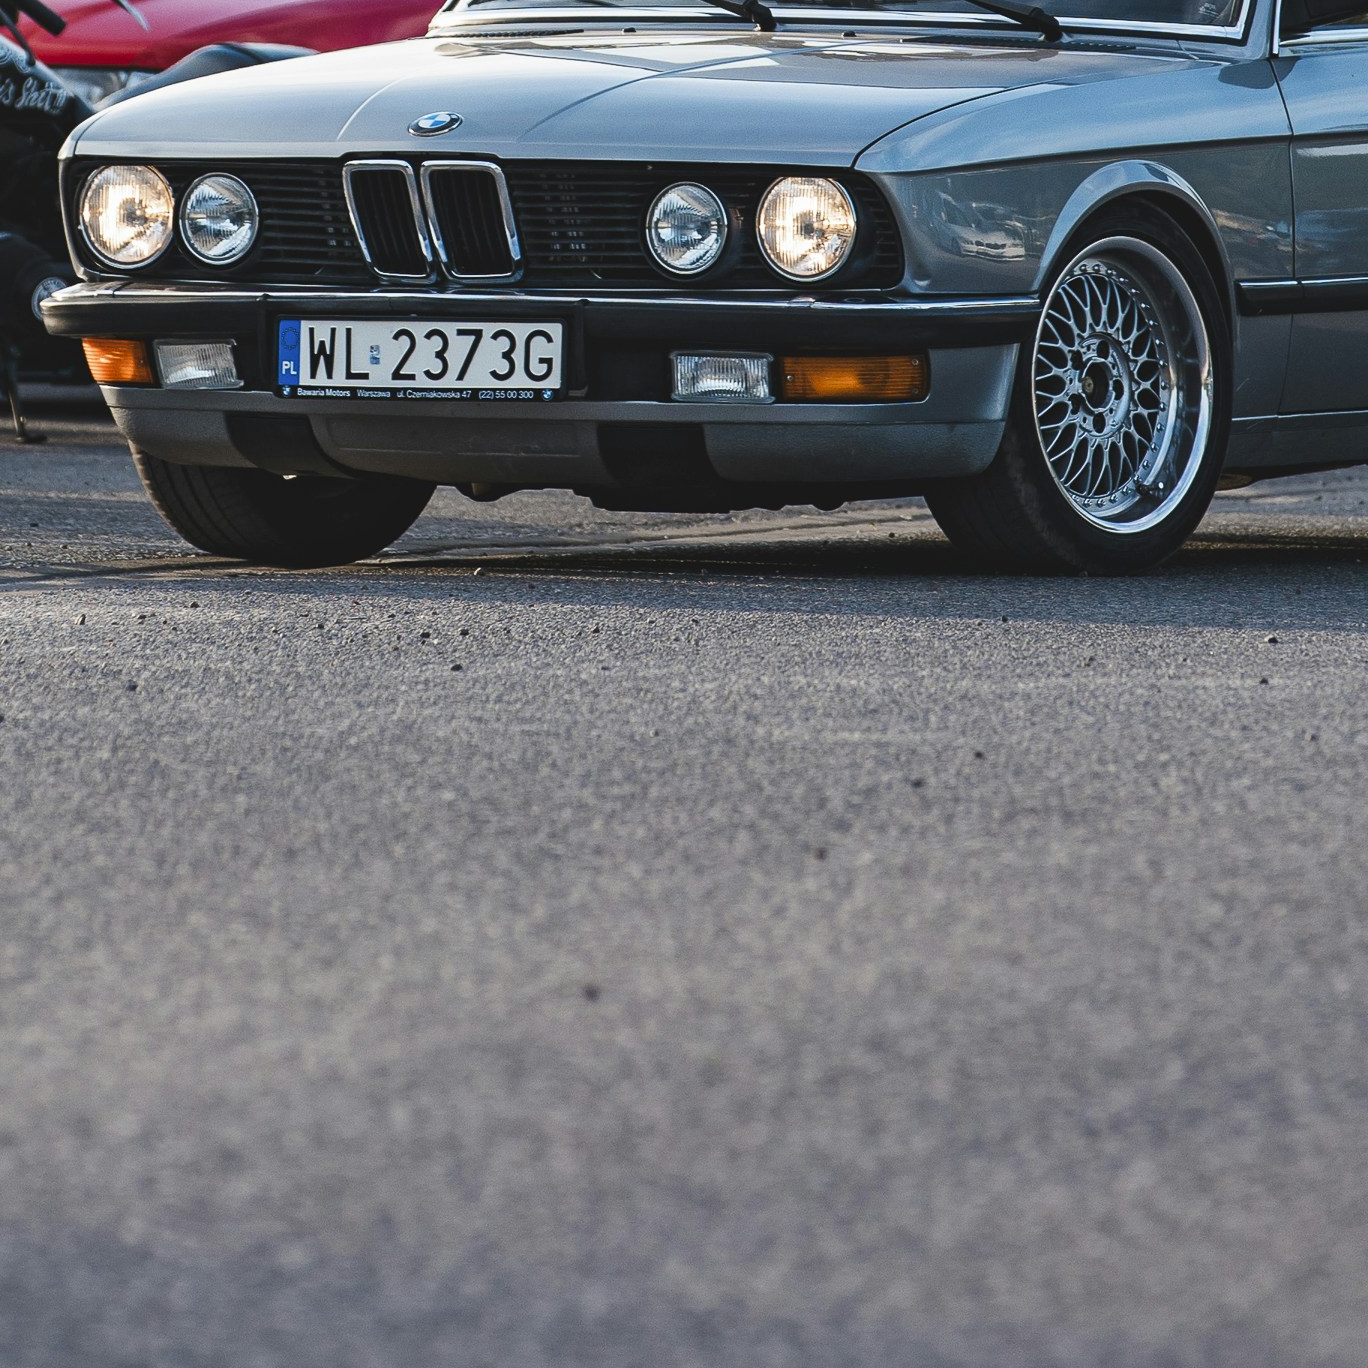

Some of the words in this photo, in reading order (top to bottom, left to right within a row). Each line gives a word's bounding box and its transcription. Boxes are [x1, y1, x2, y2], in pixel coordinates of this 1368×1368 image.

[308, 327, 370, 381] WL
[391, 328, 554, 382] 2373G
[282, 361, 297, 375] PL
[297, 388, 325, 396] Bawaria
[325, 388, 351, 397] Motors
[357, 389, 391, 398] Warszawa
[406, 390, 461, 399] Czerniakowska
[461, 390, 472, 398] 47
[478, 390, 494, 400] (22)
[495, 390, 505, 399] 55
[506, 390, 517, 399] 00
[518, 390, 534, 399] 300
